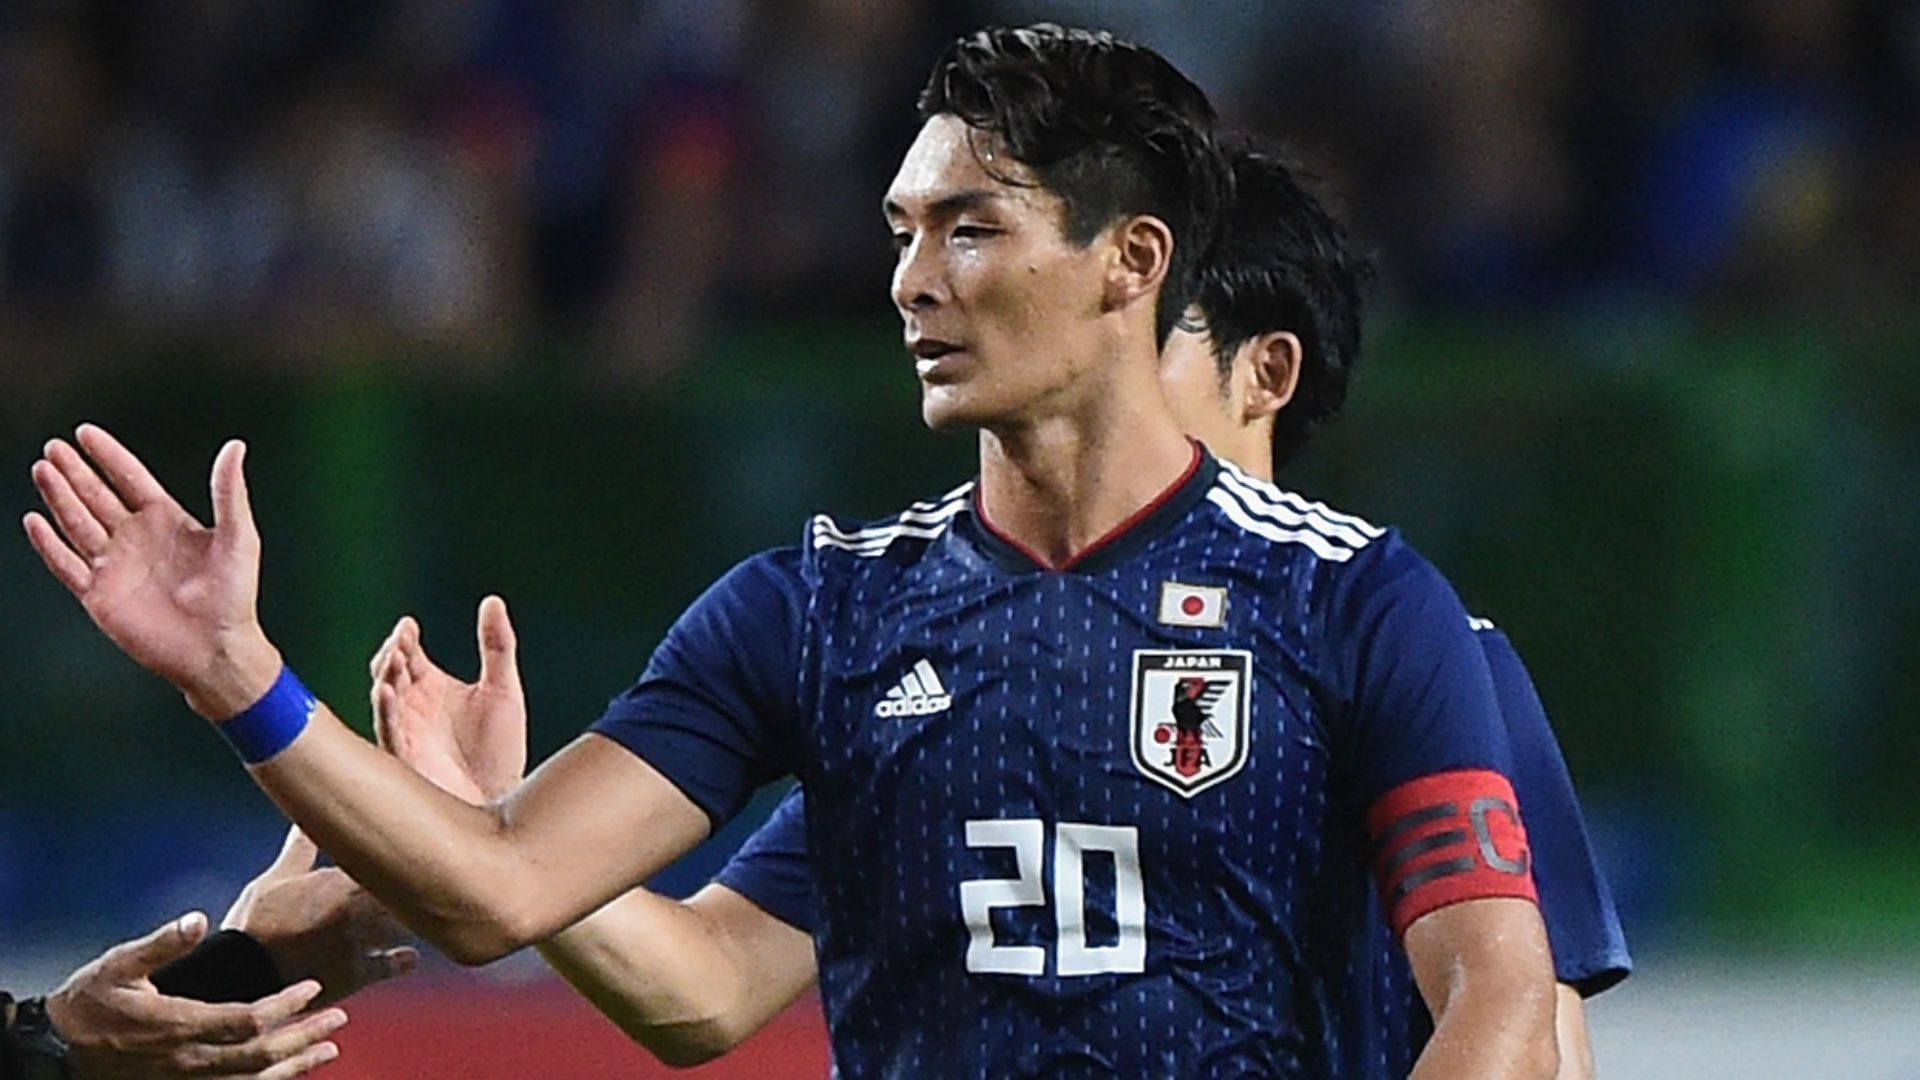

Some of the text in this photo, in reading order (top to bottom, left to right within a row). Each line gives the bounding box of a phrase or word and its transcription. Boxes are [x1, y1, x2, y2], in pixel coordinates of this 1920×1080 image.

[1163, 656, 1222, 668] JAPAN
[875, 694, 951, 718] adidas
[1163, 747, 1212, 769] JFA
[960, 819, 1146, 976] 20
